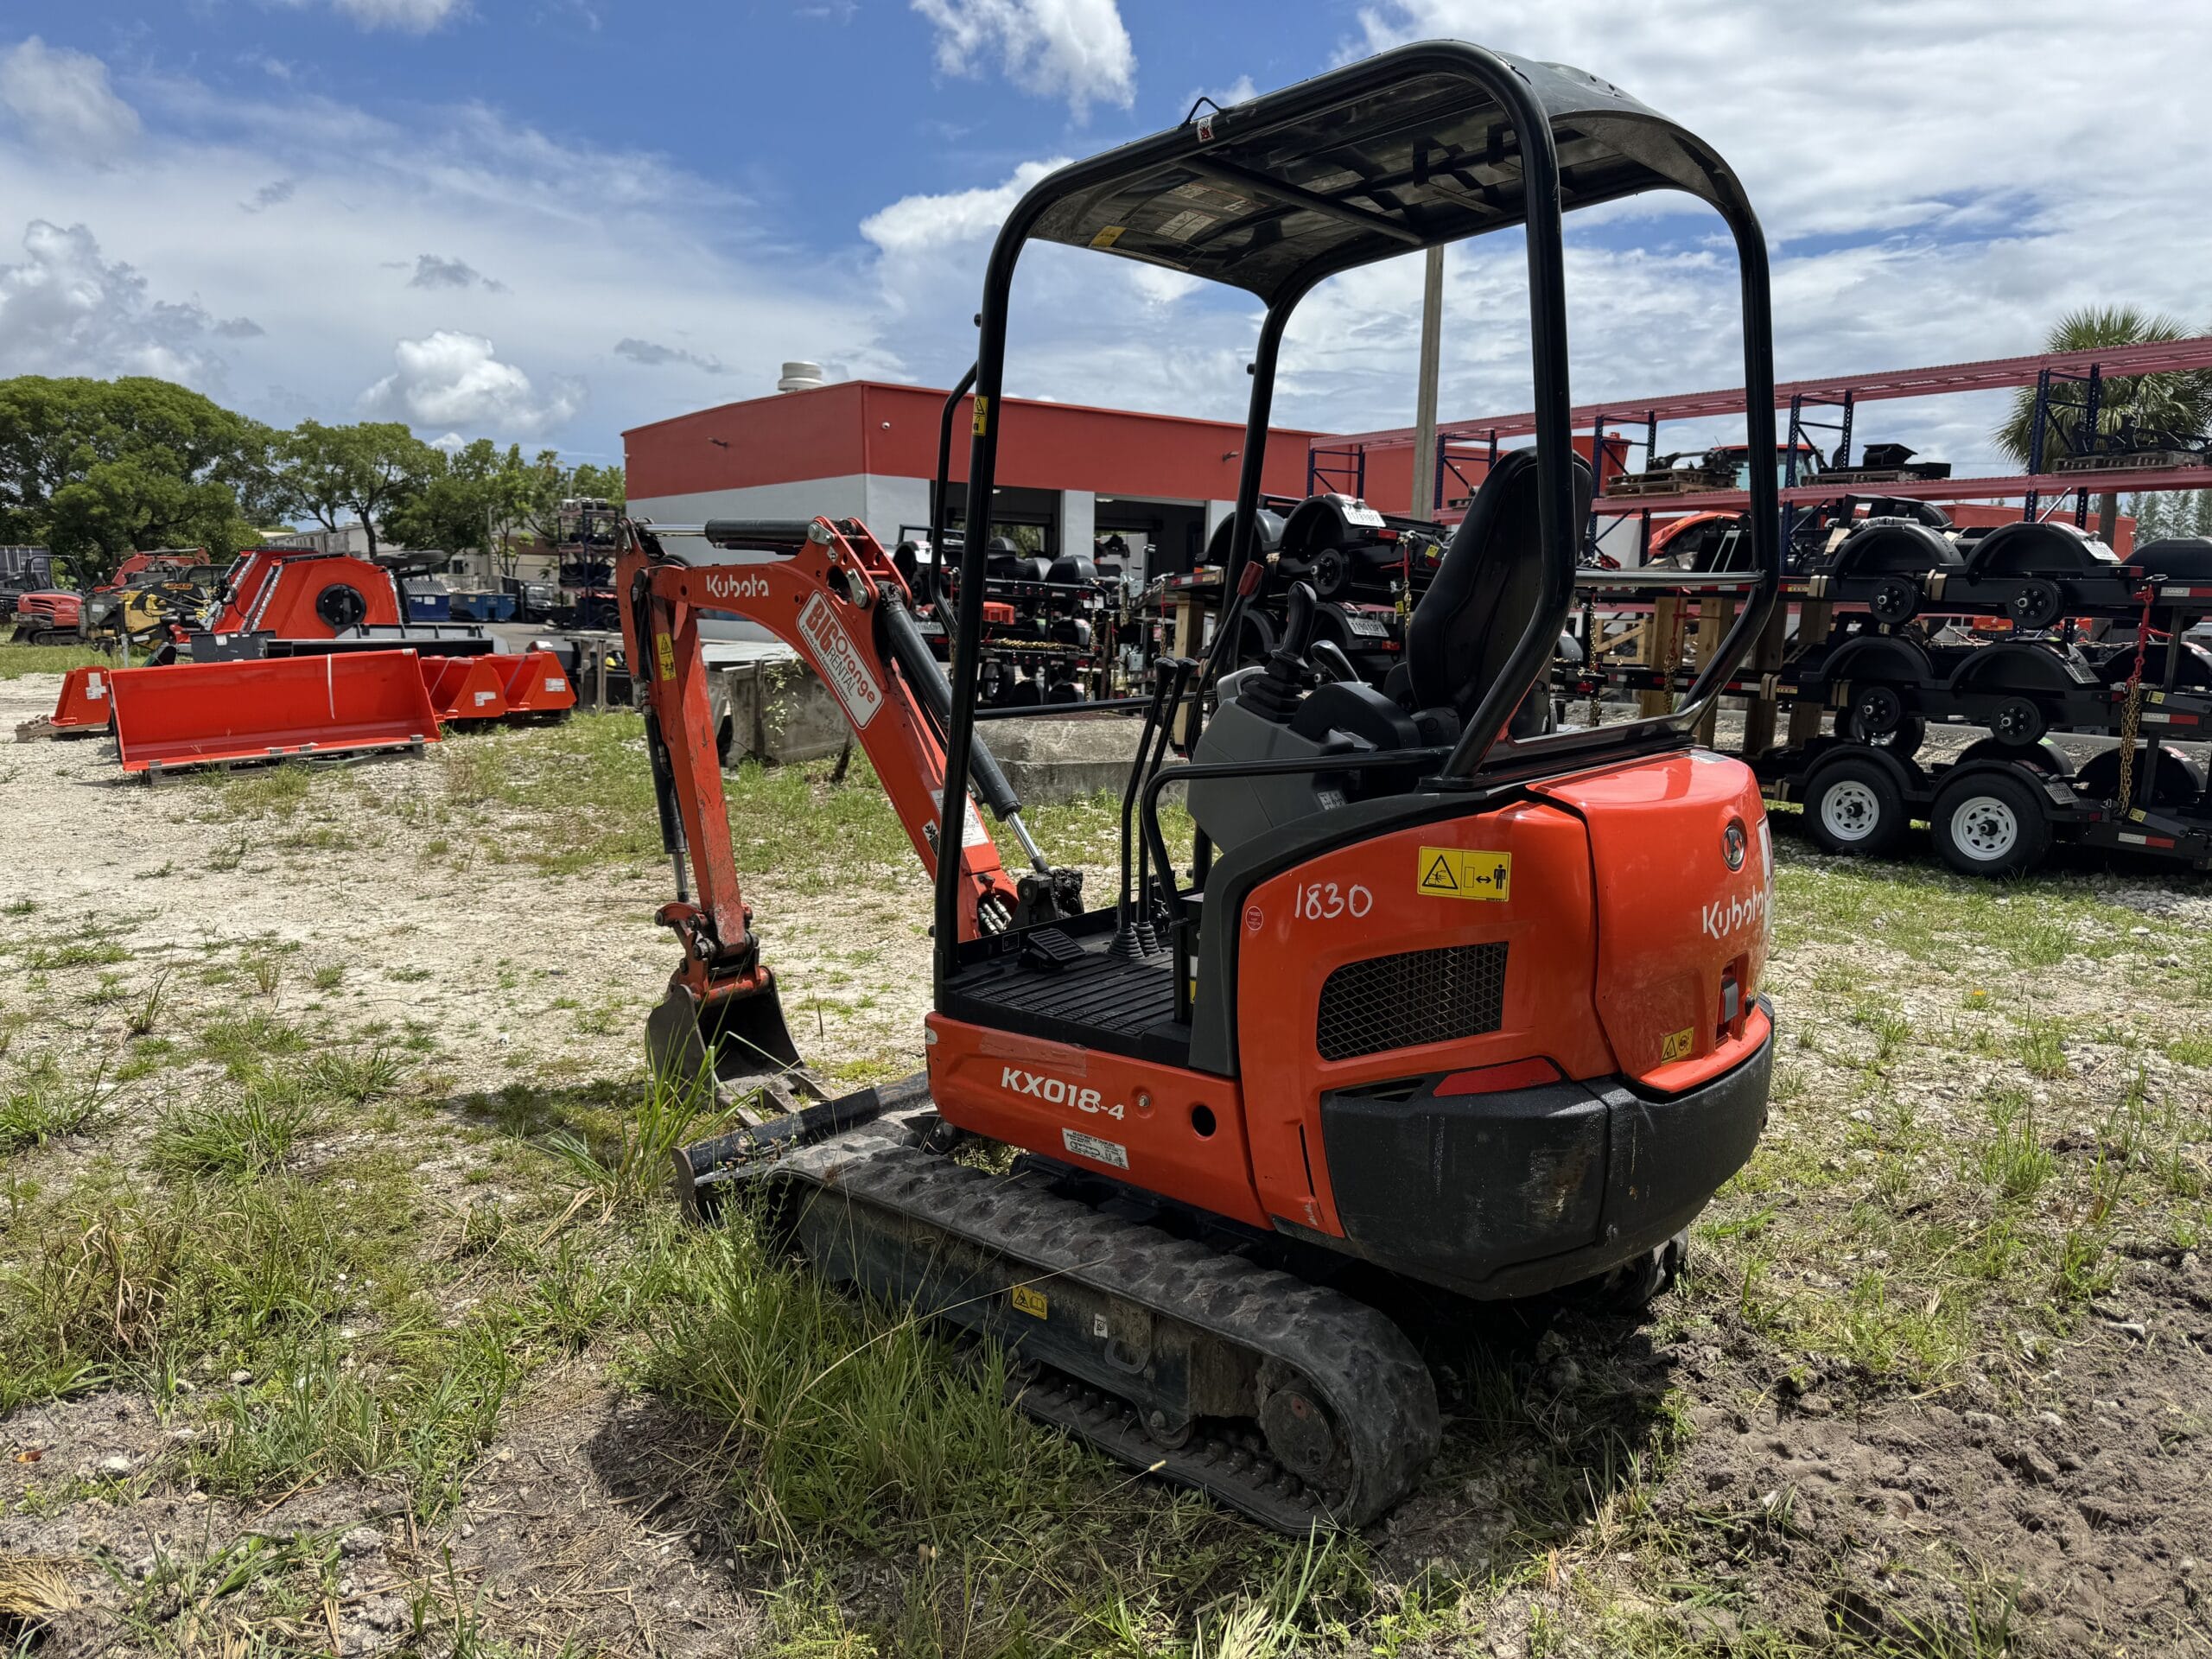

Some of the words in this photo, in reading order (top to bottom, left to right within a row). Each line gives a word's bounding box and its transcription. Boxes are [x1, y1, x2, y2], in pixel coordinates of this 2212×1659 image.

[706, 574, 769, 598] Kubota
[805, 598, 839, 654] BIG
[836, 635, 875, 704] Orange
[826, 647, 856, 696] RENTAL
[1294, 882, 1373, 920] 1830
[1702, 885, 1764, 940] Kubota
[1001, 1066, 1125, 1121] KX018-4
